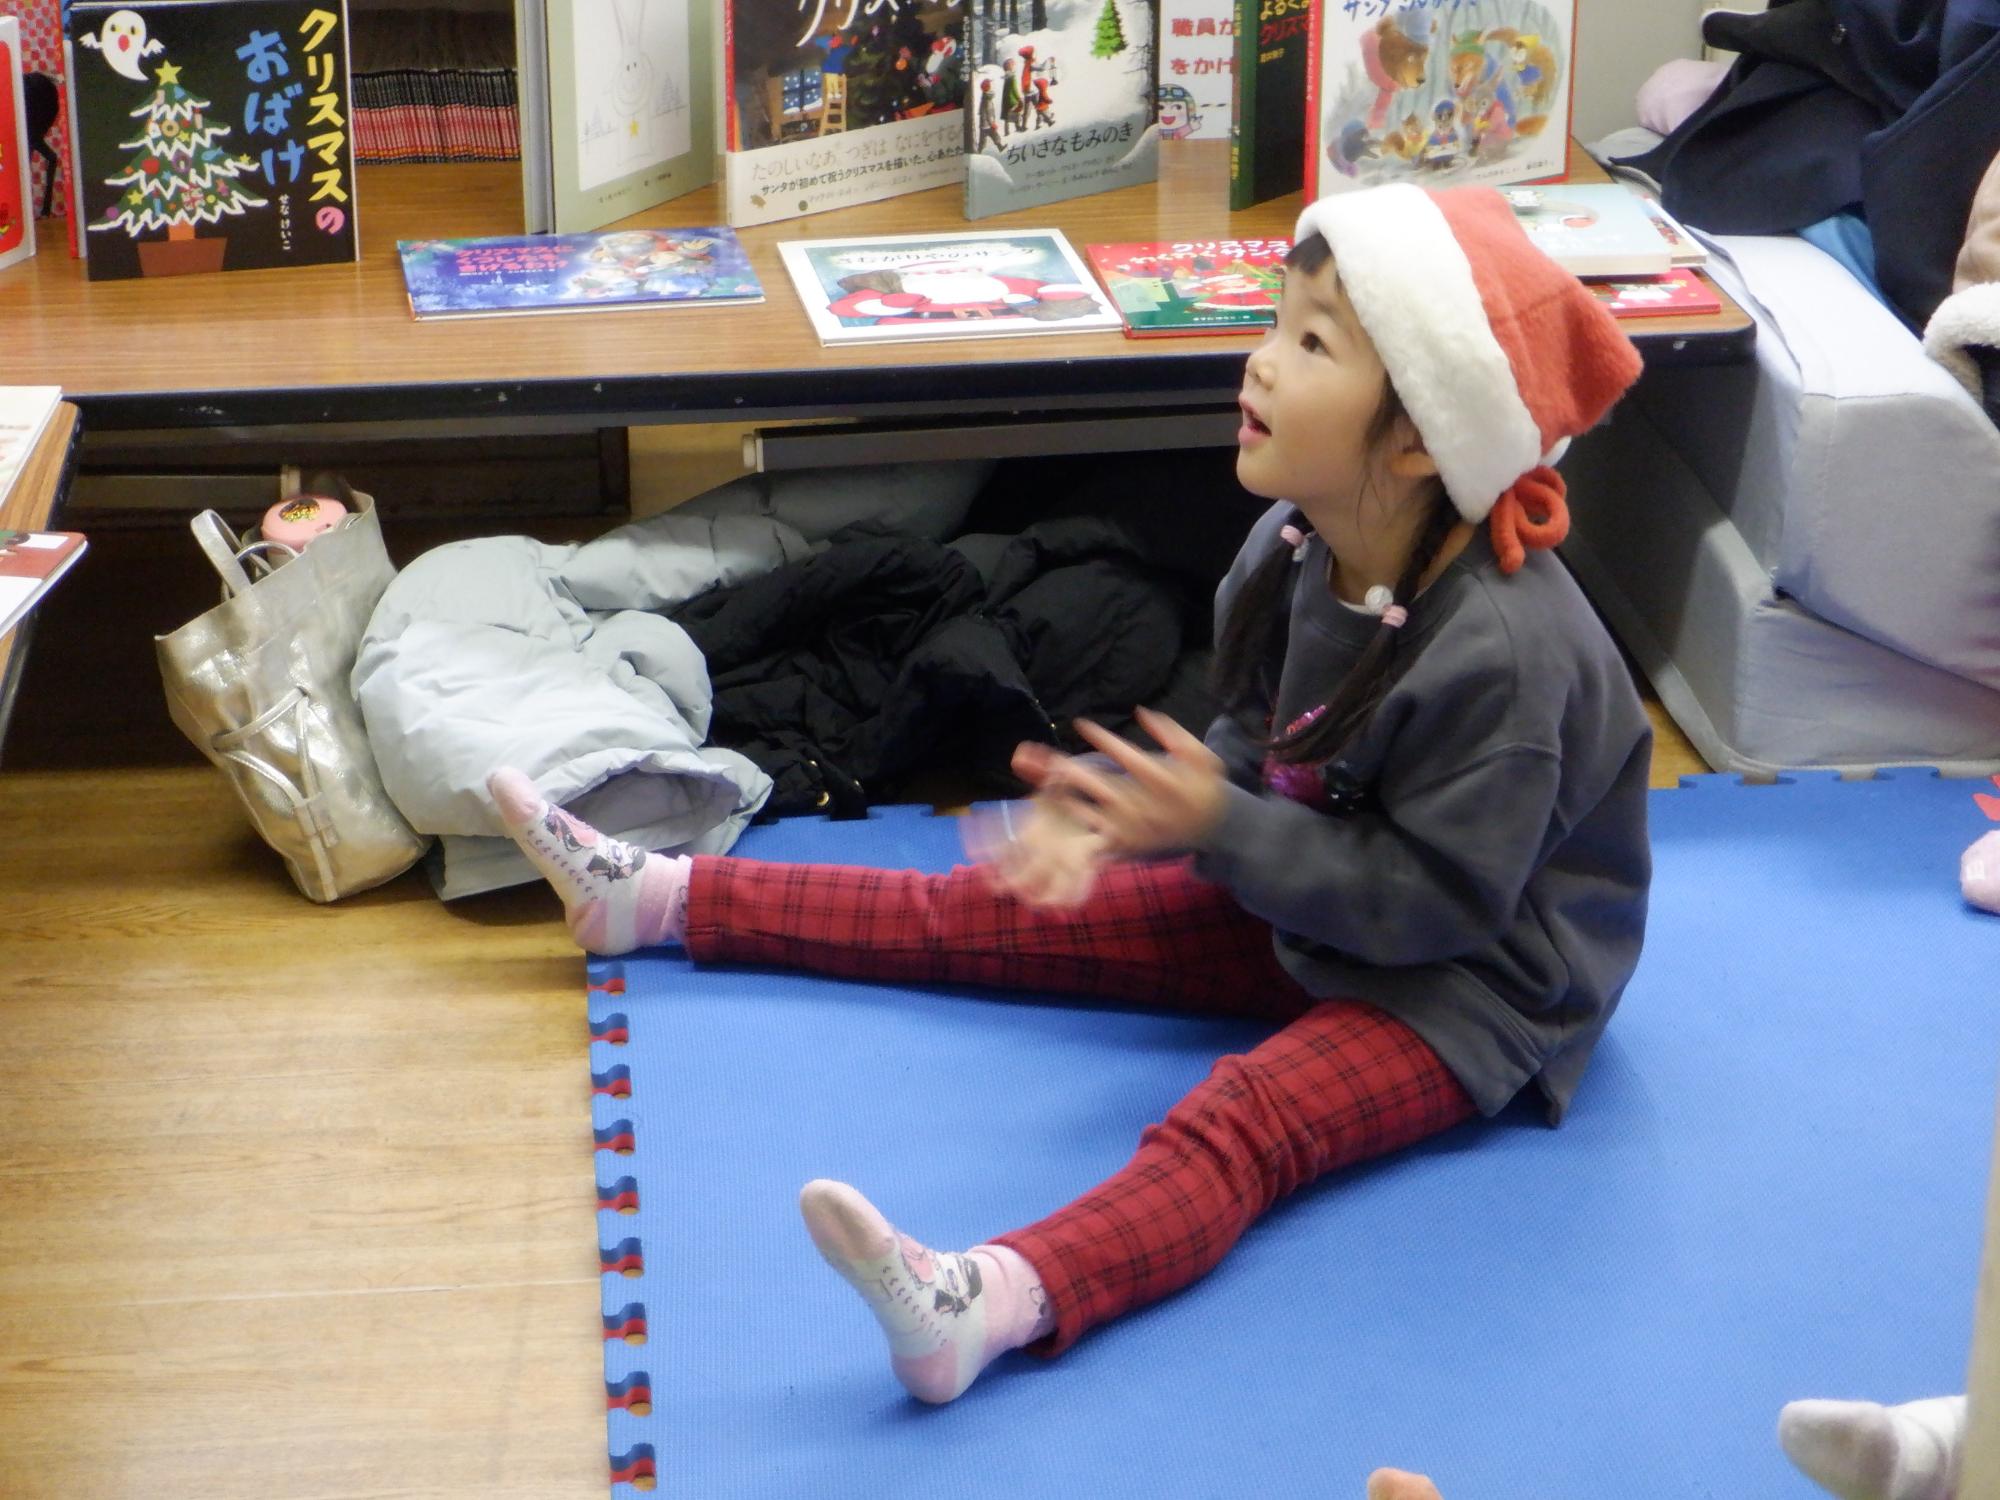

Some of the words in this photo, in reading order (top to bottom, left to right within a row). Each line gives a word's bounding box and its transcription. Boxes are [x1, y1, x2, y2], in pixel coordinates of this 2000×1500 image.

[236, 30, 305, 185] おばけ
[1007, 121, 1133, 166] ちいさなもみのき
[1172, 240, 1290, 252] クリスマス
